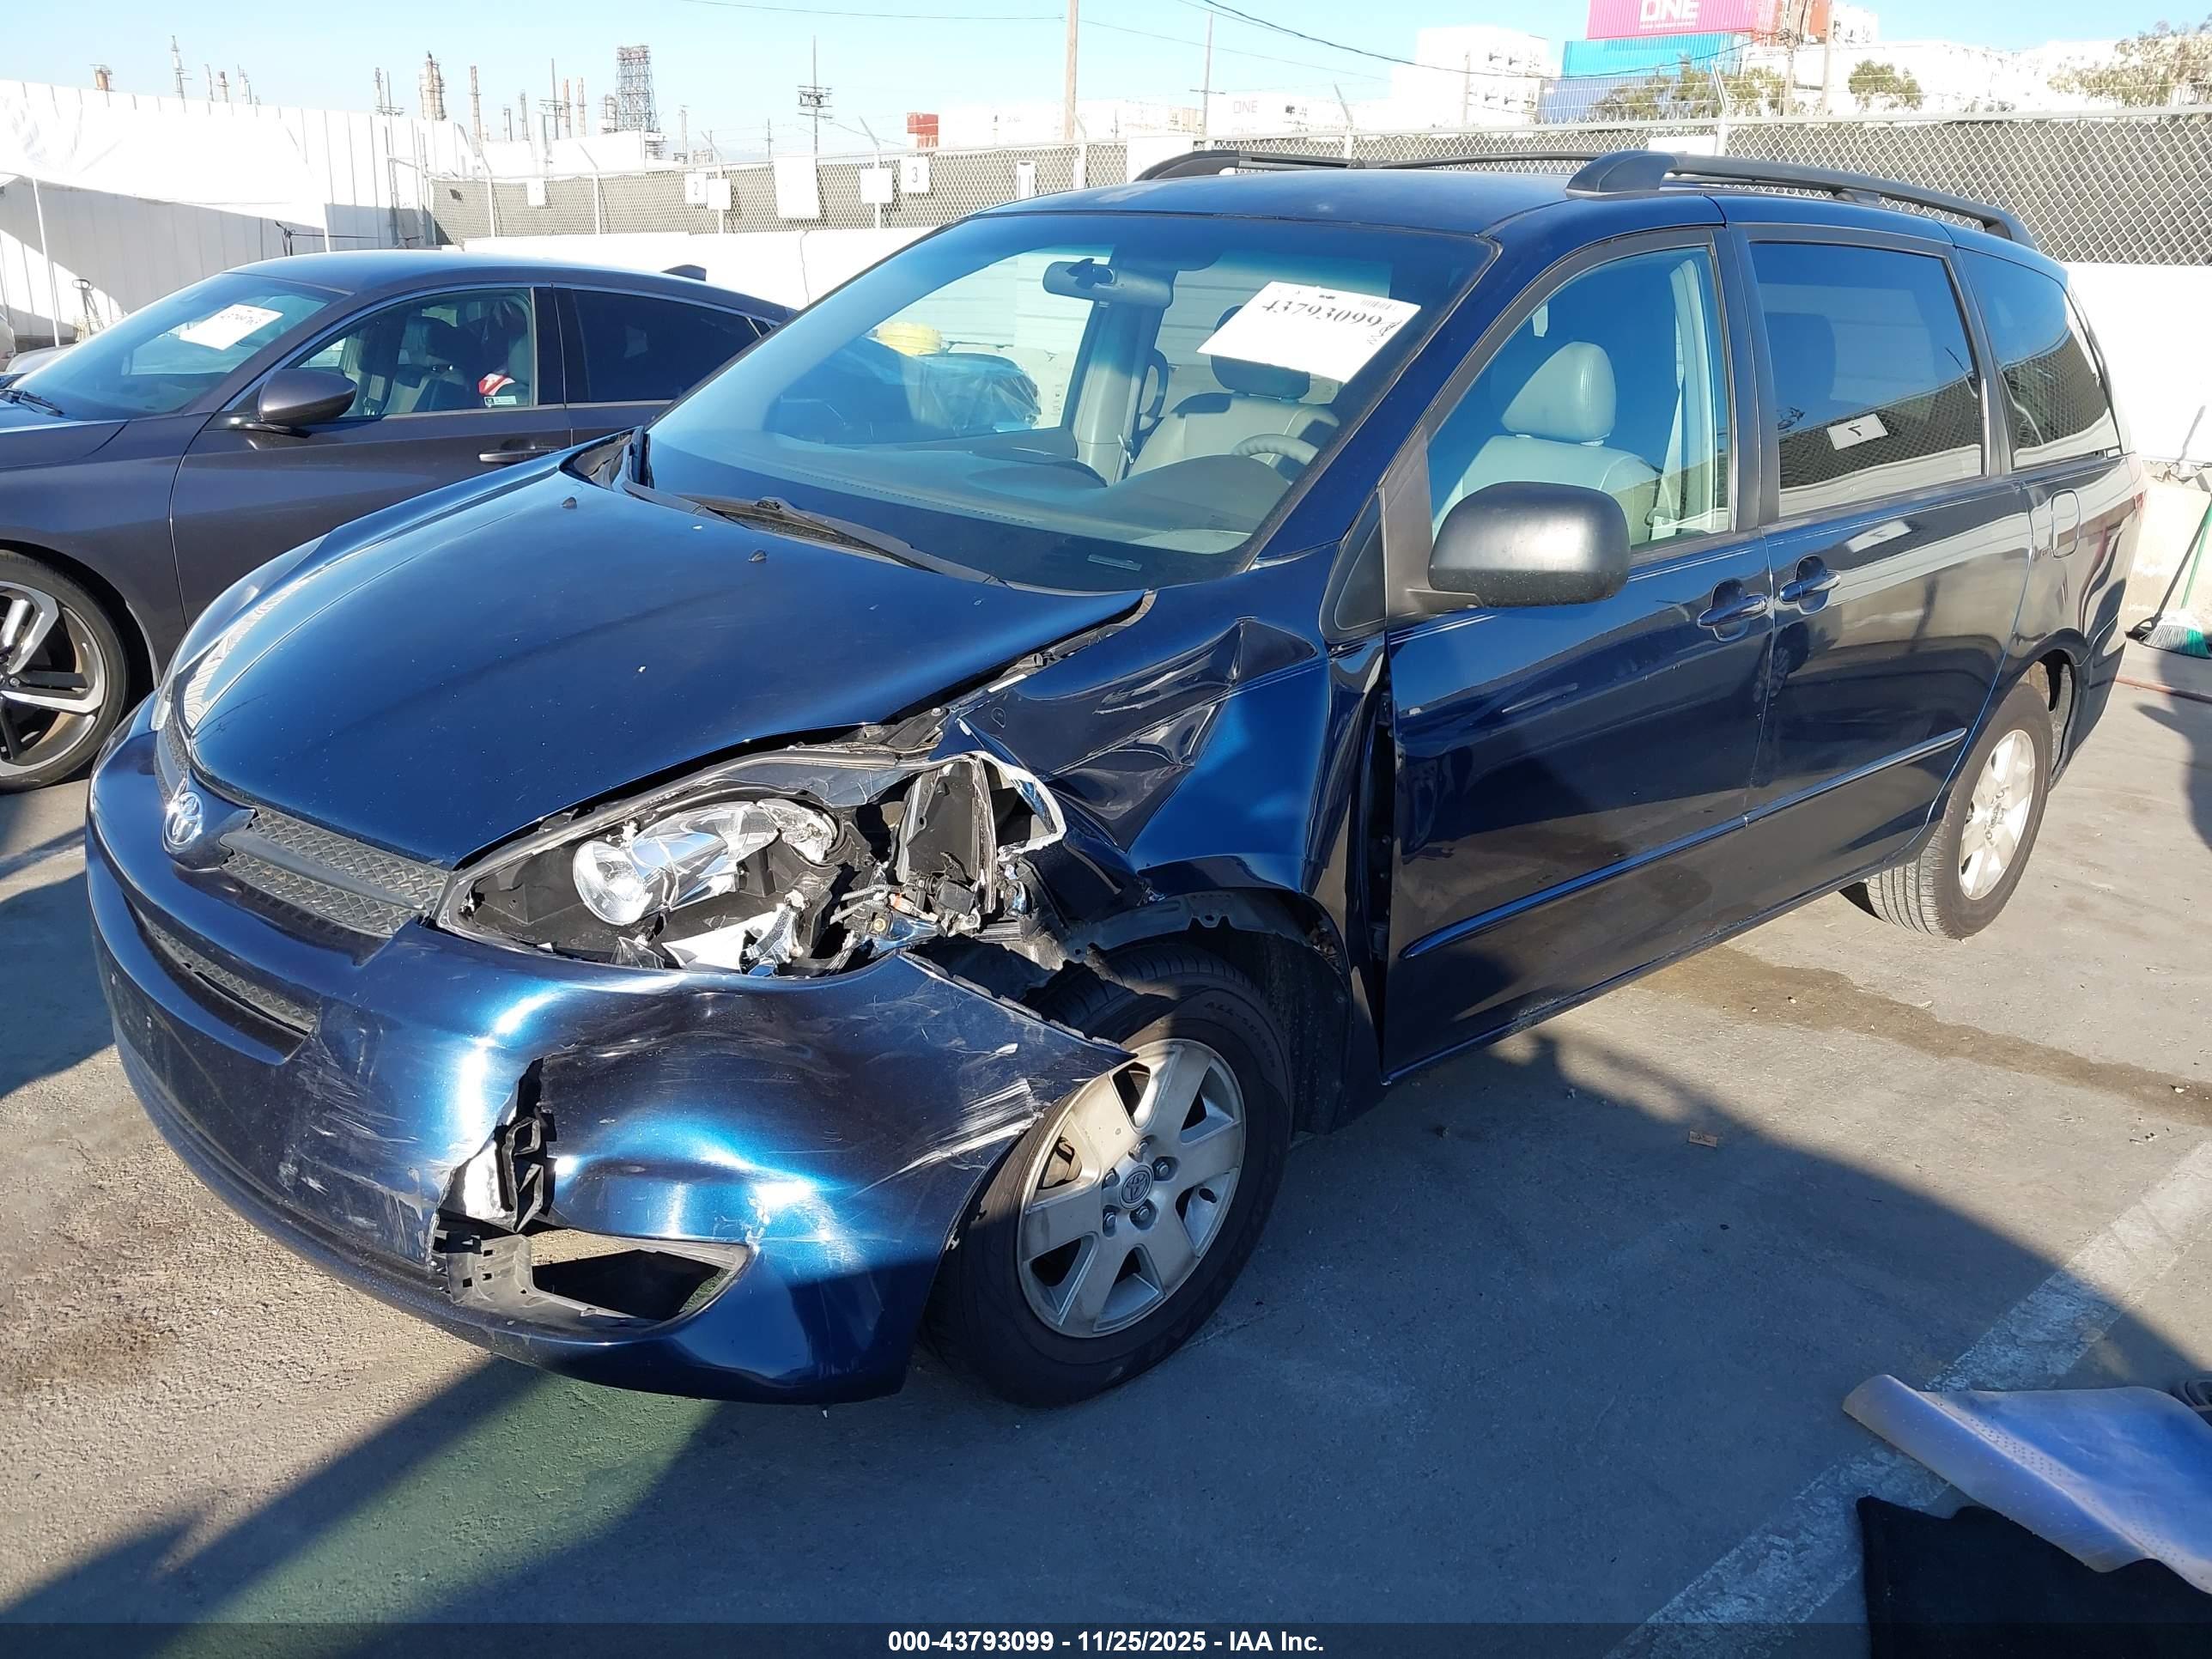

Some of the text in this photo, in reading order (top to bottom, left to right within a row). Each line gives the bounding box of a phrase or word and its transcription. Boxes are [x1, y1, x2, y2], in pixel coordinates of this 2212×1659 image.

[1639, 0, 1699, 21] ONE
[1233, 100, 1258, 114] ONE
[911, 166, 919, 184] 3
[1261, 298, 1385, 327] 43793099
